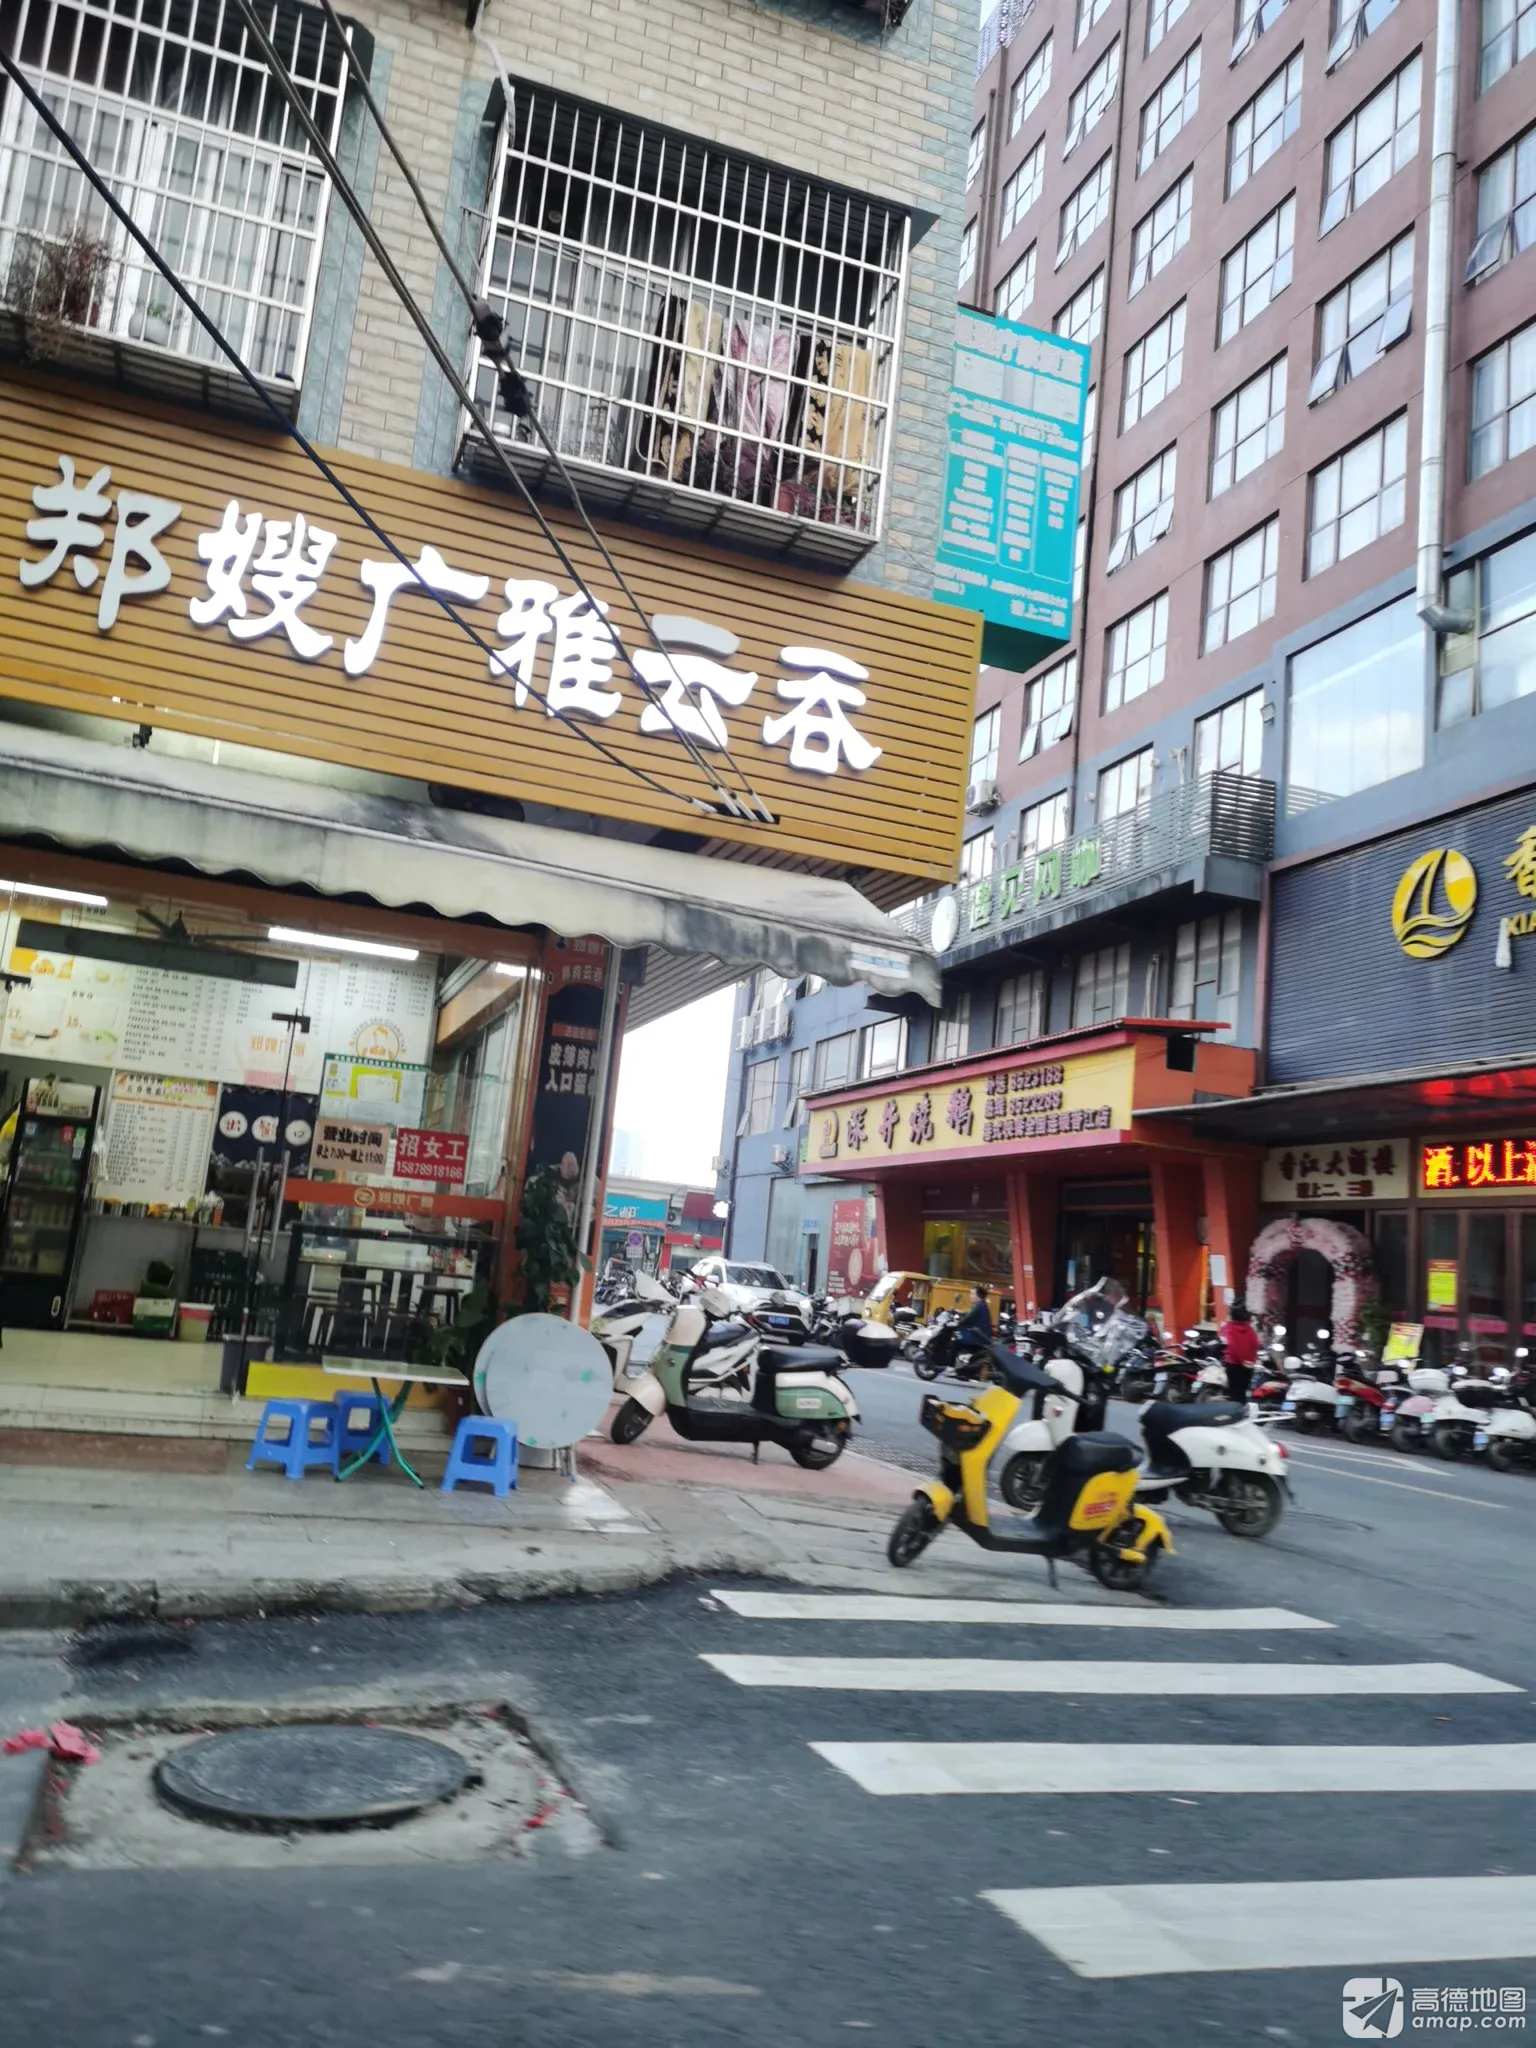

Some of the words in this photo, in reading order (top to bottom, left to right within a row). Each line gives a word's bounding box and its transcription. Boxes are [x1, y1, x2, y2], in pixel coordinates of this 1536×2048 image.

[19, 454, 883, 776] 郑嫂广雅云吞
[323, 1125, 383, 1148] 营业时间
[399, 1133, 465, 1161] 招女工
